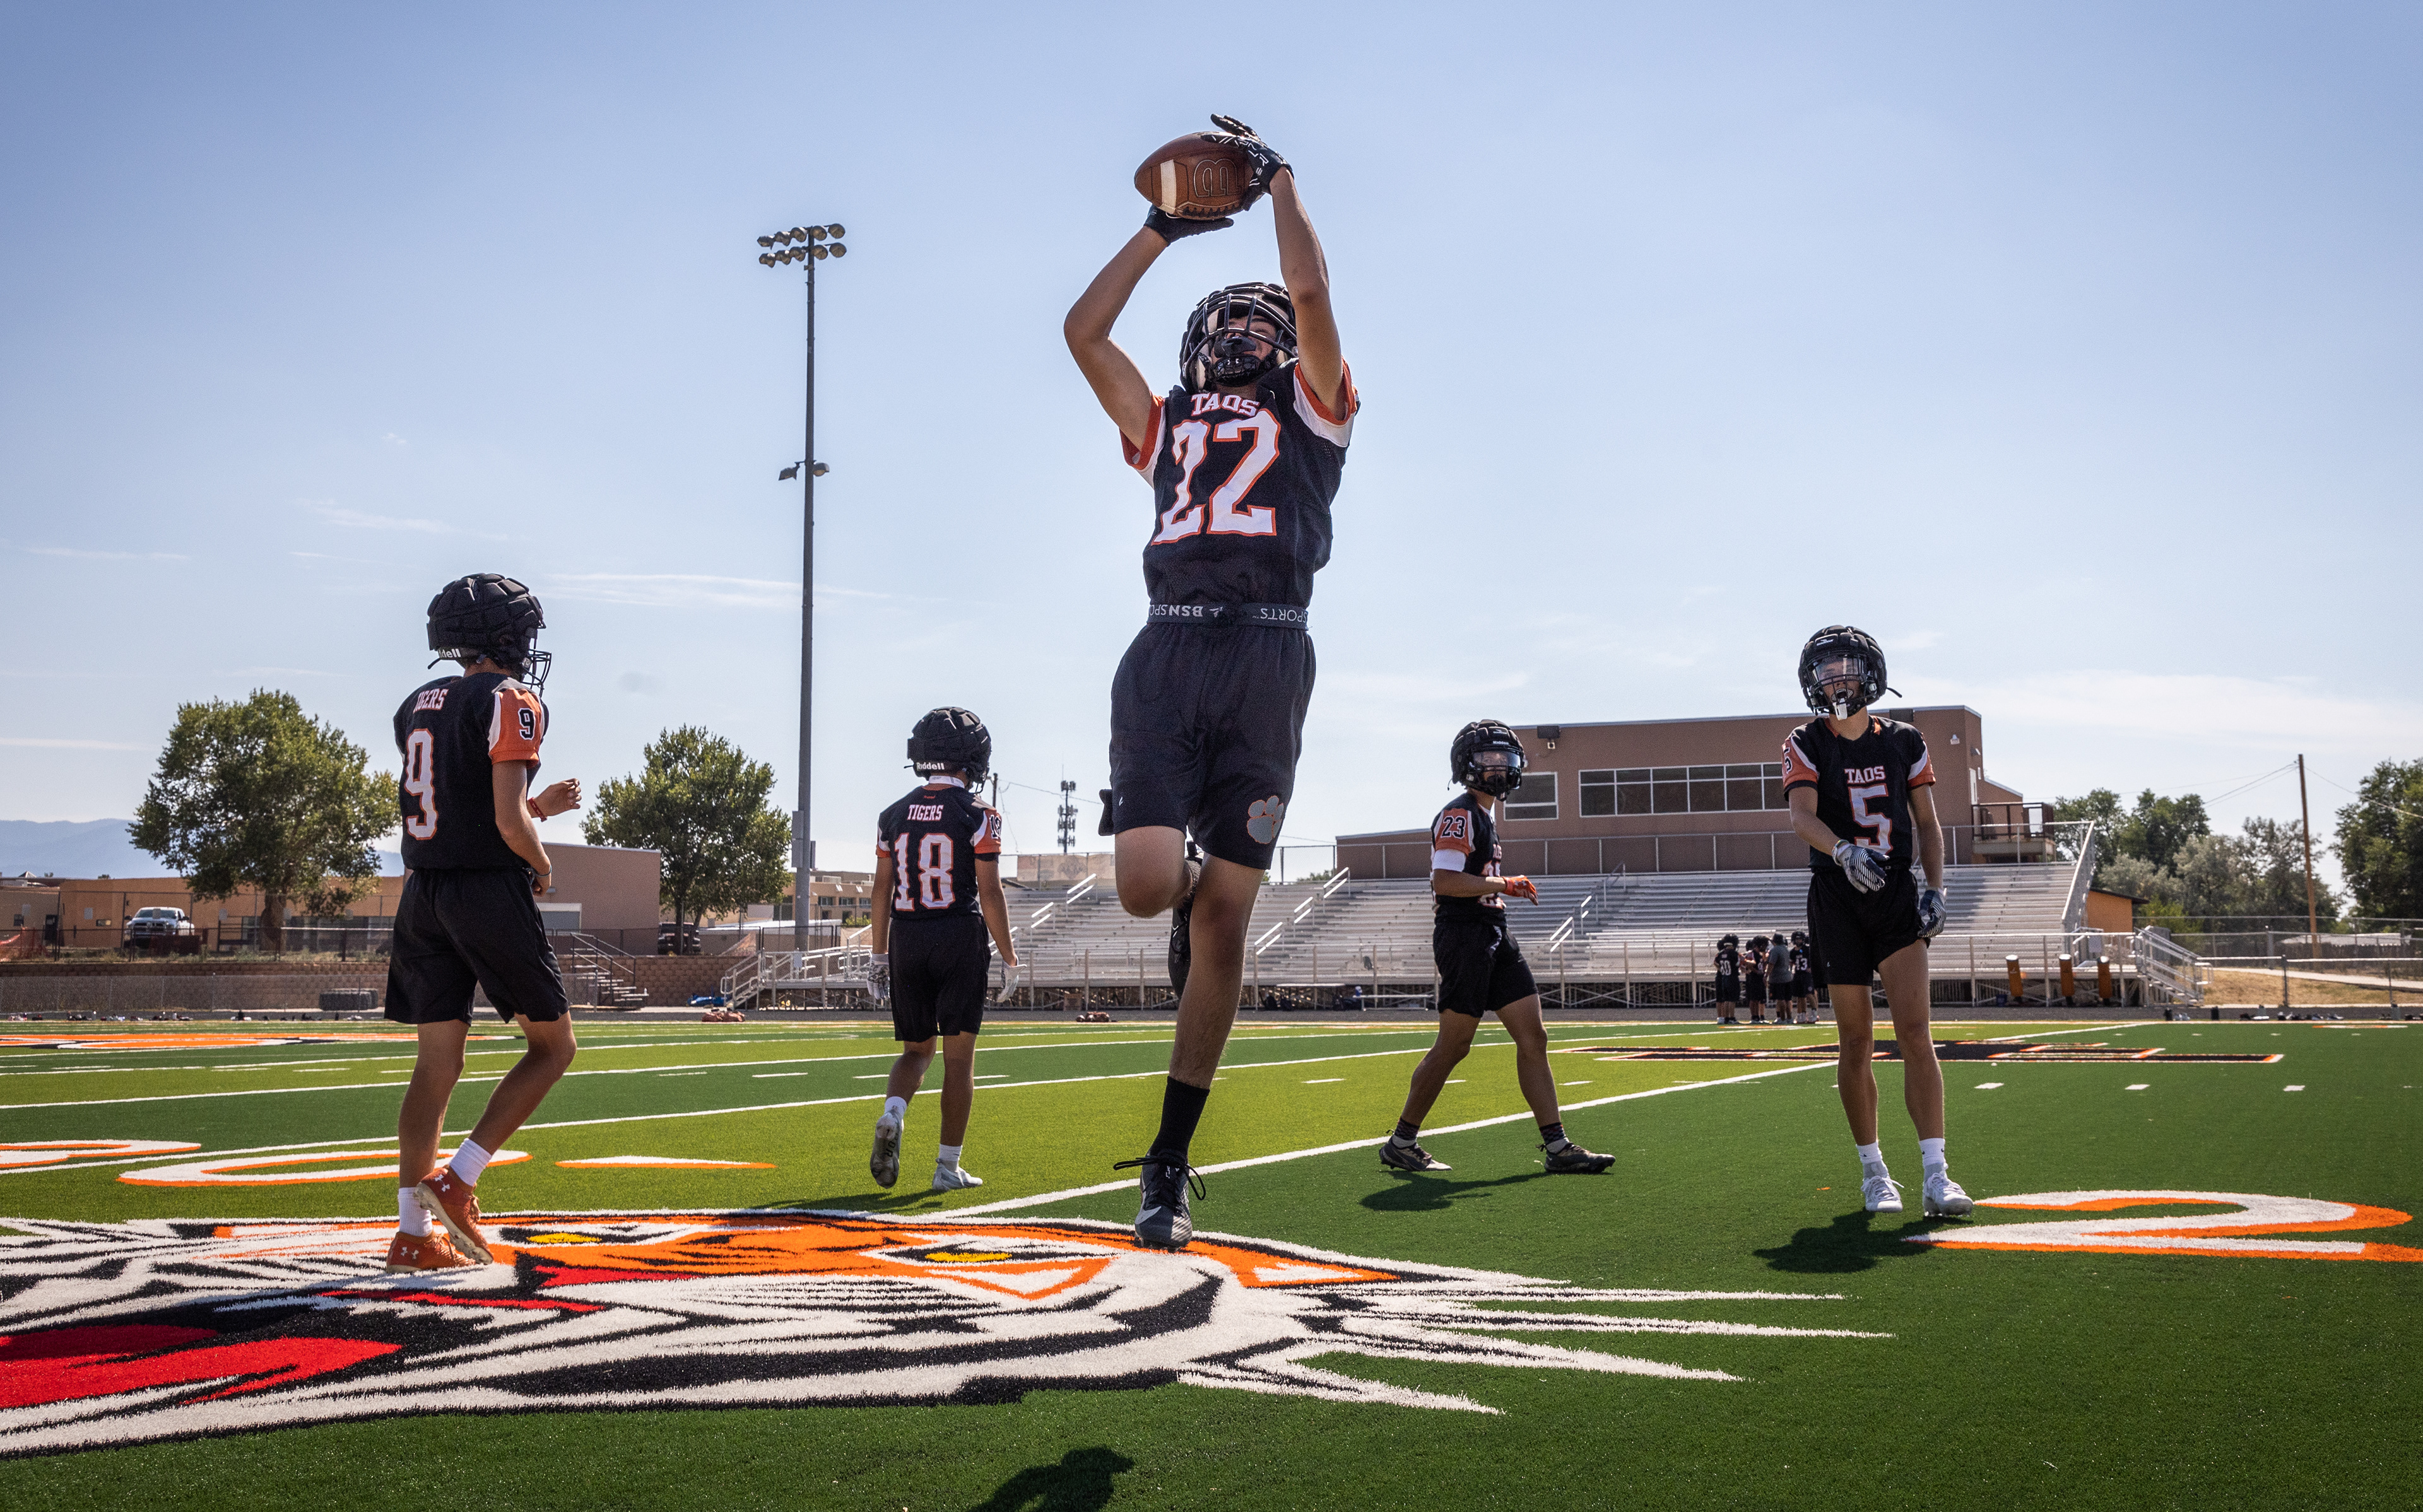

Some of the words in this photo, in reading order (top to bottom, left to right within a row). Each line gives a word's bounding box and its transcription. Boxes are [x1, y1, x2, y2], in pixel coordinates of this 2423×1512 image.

[1191, 392, 1261, 418] TAOS
[1151, 407, 1282, 546] 22
[1169, 604, 1203, 617] BSN
[413, 688, 449, 714] IGERS
[517, 708, 536, 740] 9
[916, 761, 945, 771] Riddell
[1844, 765, 1887, 784] TAOS
[406, 728, 439, 840] 9
[907, 804, 944, 821] TIGERS
[1848, 782, 1894, 856] 5
[1439, 815, 1467, 840] 23
[894, 832, 956, 912] 18
